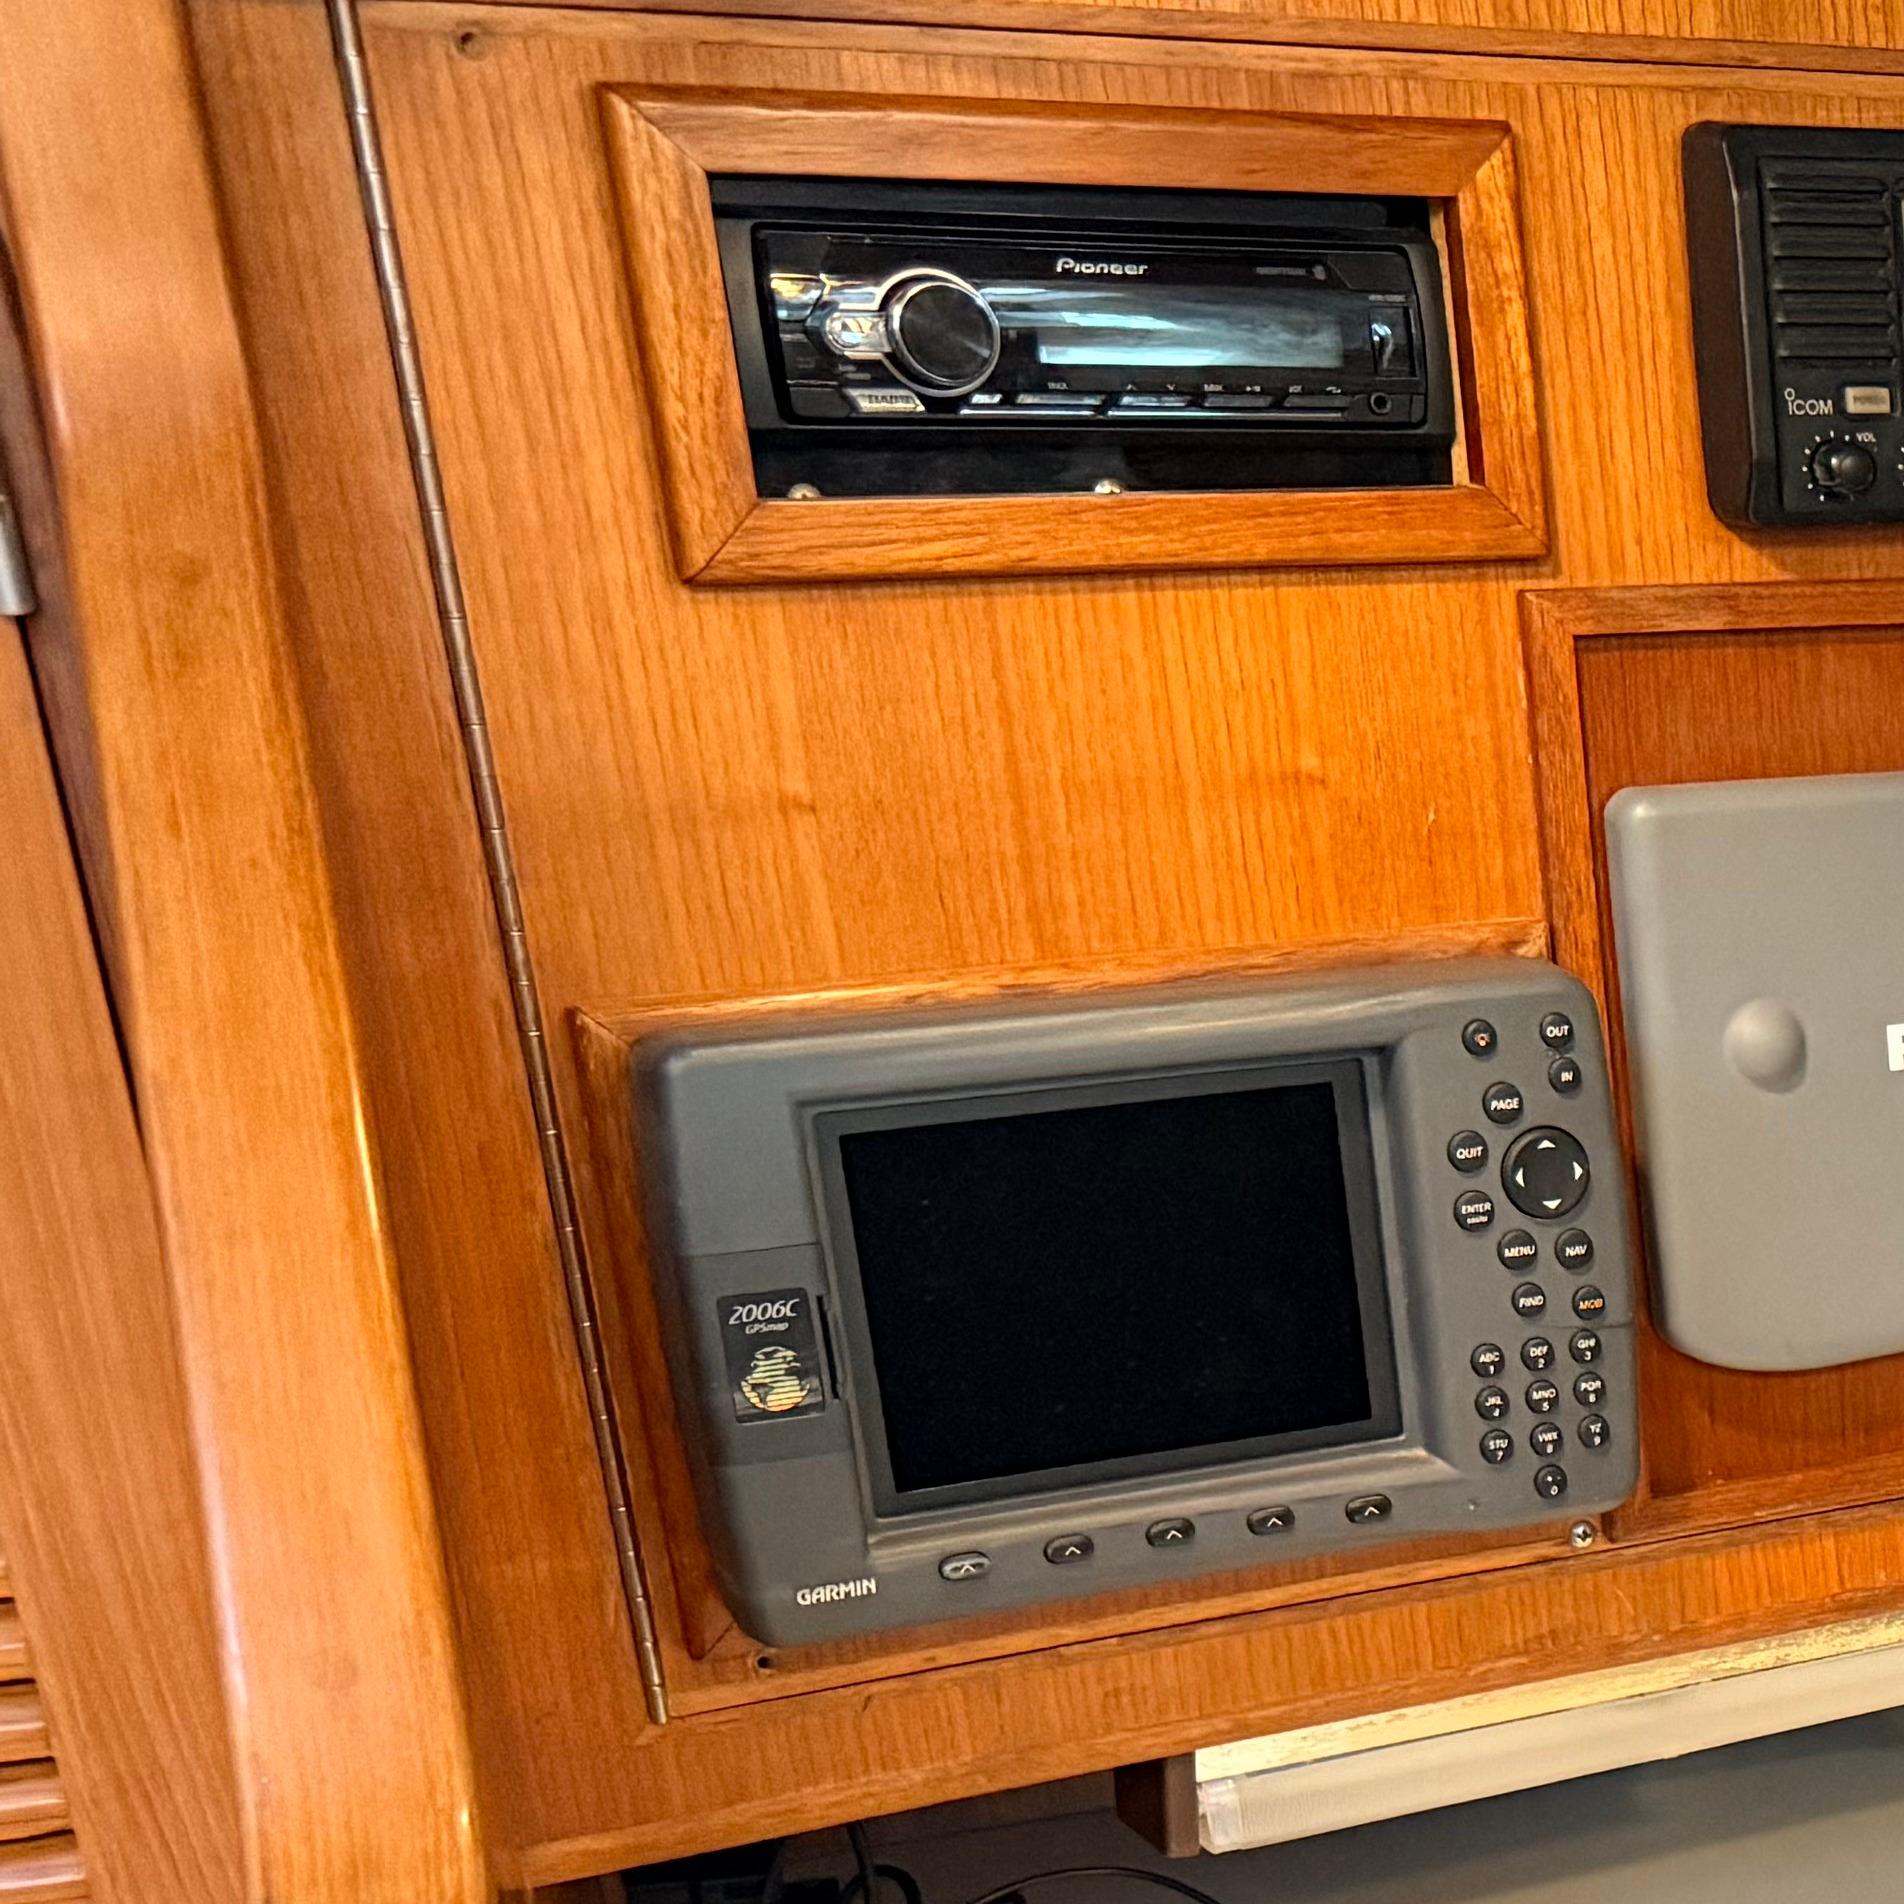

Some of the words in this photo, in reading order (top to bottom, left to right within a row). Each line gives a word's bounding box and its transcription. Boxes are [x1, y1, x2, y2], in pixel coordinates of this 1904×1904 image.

[1056, 258, 1147, 276] Pioneer
[1546, 1025, 1569, 1037] OUT
[1561, 1071, 1573, 1082] IN
[1491, 1098, 1519, 1110] PAGE
[1456, 1146, 1484, 1159] QUIT
[1461, 1202, 1492, 1214] ENTER
[1504, 1245, 1535, 1258] MENU
[1565, 1244, 1587, 1257] NAV
[1519, 1295, 1544, 1308] FIND
[728, 1299, 800, 1325] 2006C
[1577, 1338, 1596, 1350] GHI
[1529, 1345, 1548, 1357] DEF
[1584, 1351, 1592, 1361] 3
[1478, 1352, 1500, 1363] ABC
[1538, 1358, 1545, 1368] 2
[1532, 1388, 1556, 1400] MNO
[1542, 1401, 1550, 1411] 5
[1489, 1438, 1508, 1450] STU
[1497, 1451, 1503, 1462] 7
[1550, 1484, 1558, 1496] 0
[796, 1578, 877, 1606] GARMIN
